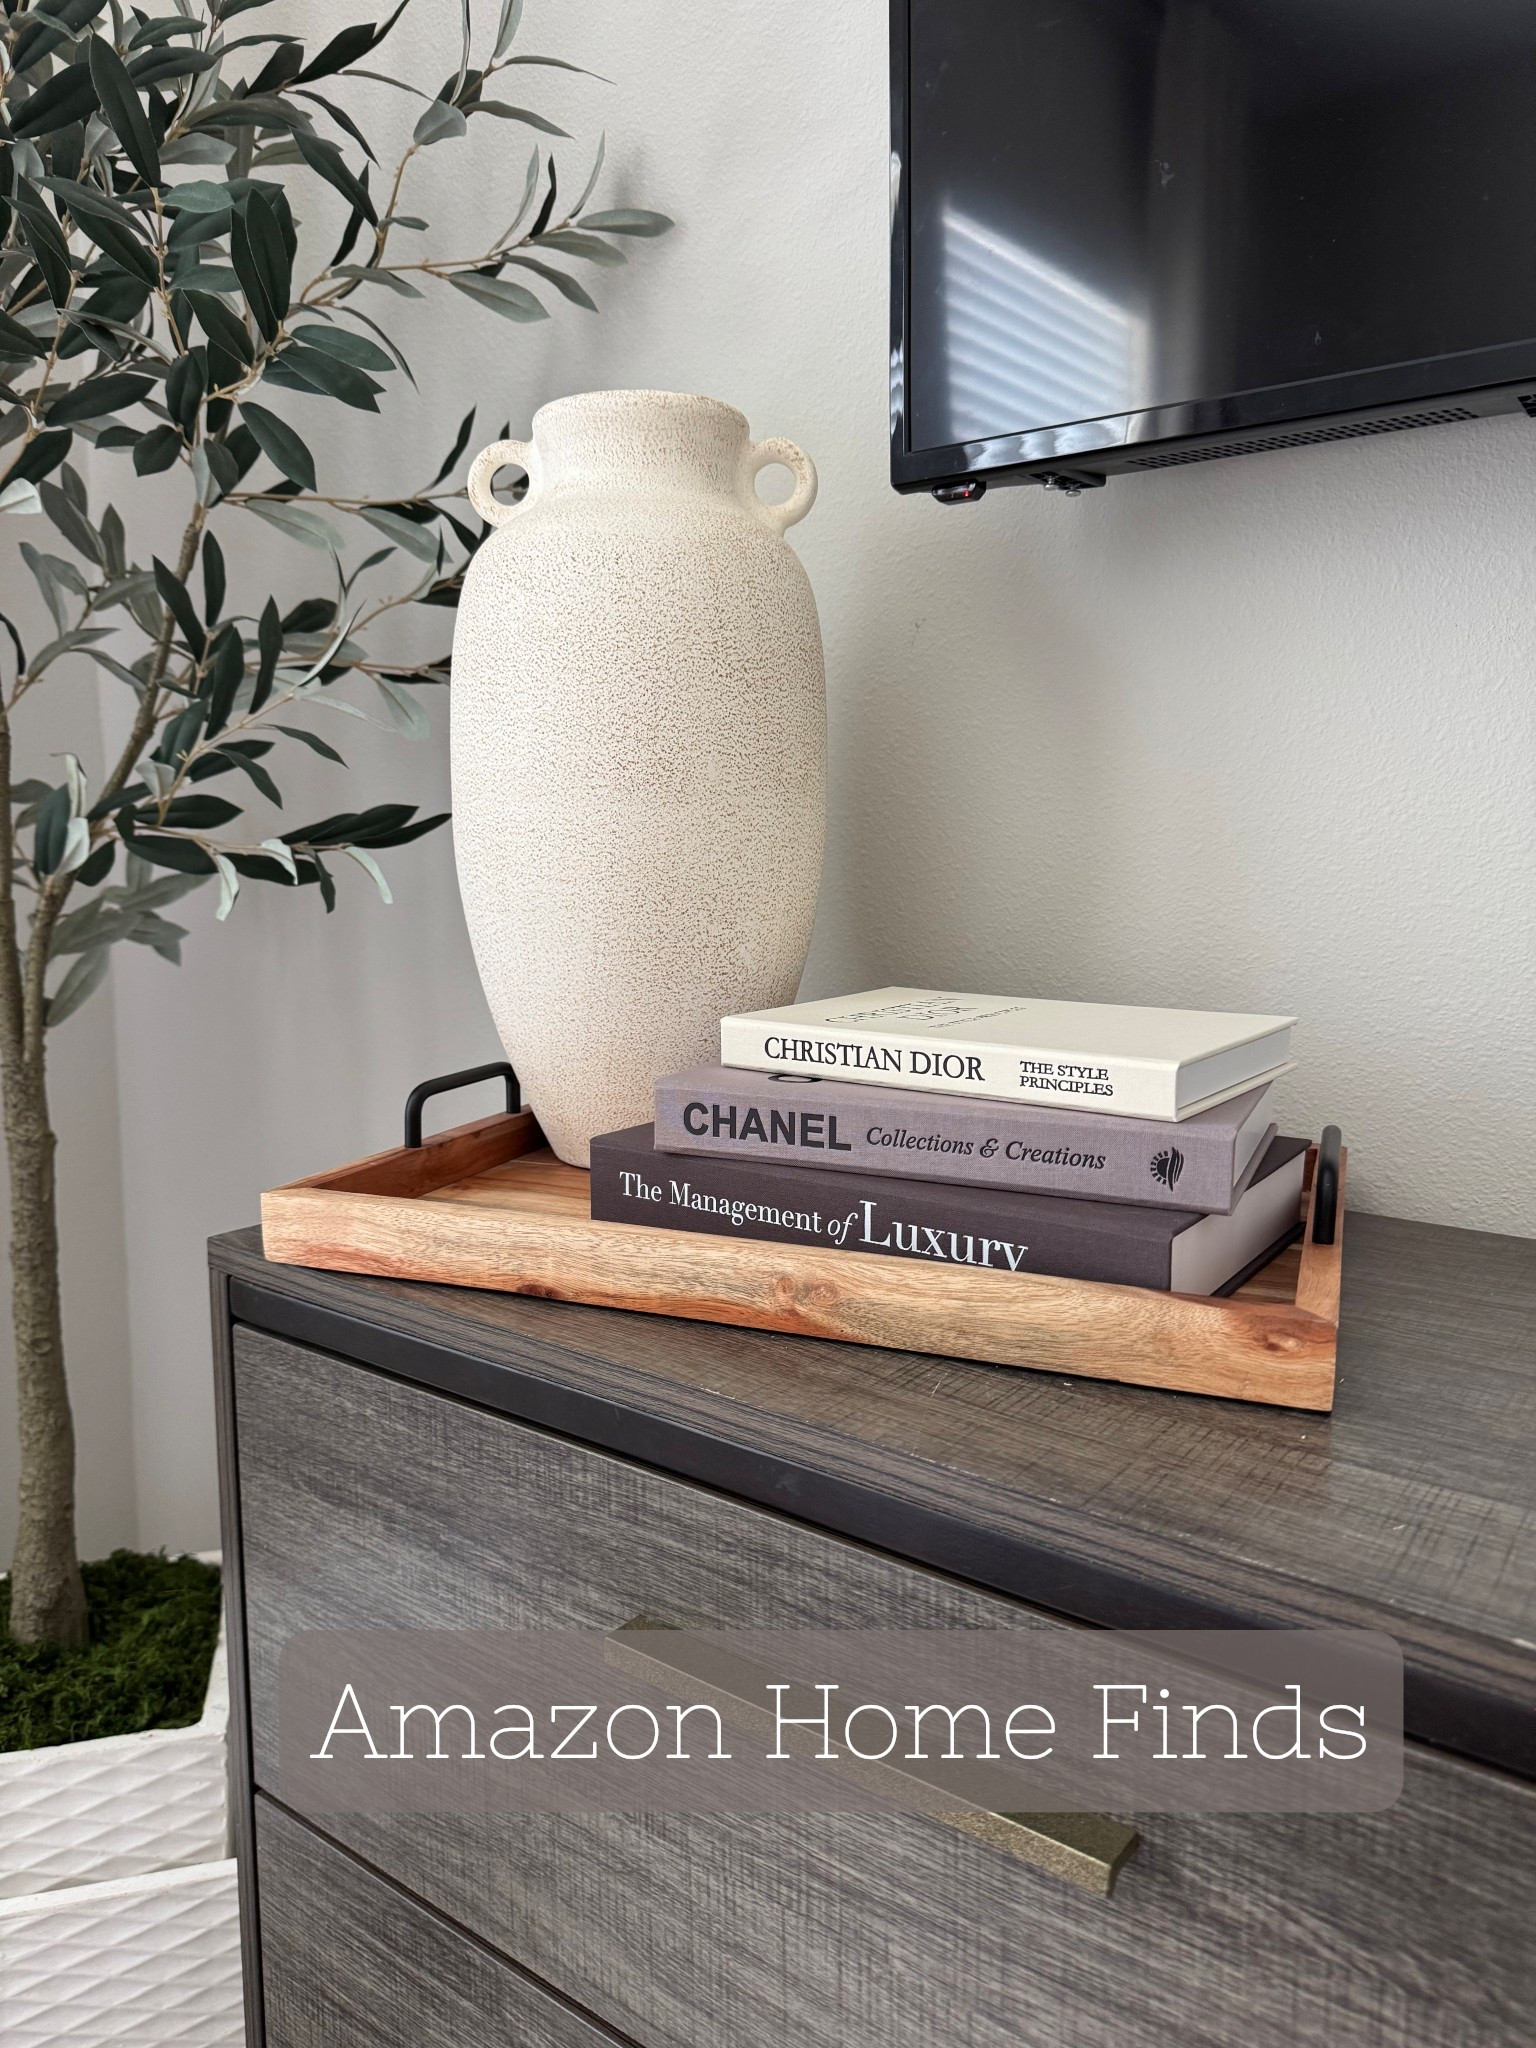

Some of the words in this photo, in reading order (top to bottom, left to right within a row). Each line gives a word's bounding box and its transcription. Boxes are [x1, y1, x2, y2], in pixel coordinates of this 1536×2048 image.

[764, 1036, 902, 1072] CHRISTIAN
[909, 1051, 985, 1081] DIOR
[1019, 1060, 1053, 1075] THE
[1057, 1065, 1109, 1081] STYLE
[1019, 1075, 1114, 1097] PRINCIPLES
[683, 1102, 852, 1151] CHANEL
[866, 1126, 974, 1155] Collections
[979, 1138, 999, 1158] &
[1005, 1141, 1106, 1170] Creations
[619, 1171, 662, 1202] The
[669, 1180, 822, 1234] Management
[827, 1212, 859, 1245] of
[859, 1200, 1029, 1272] Luxury
